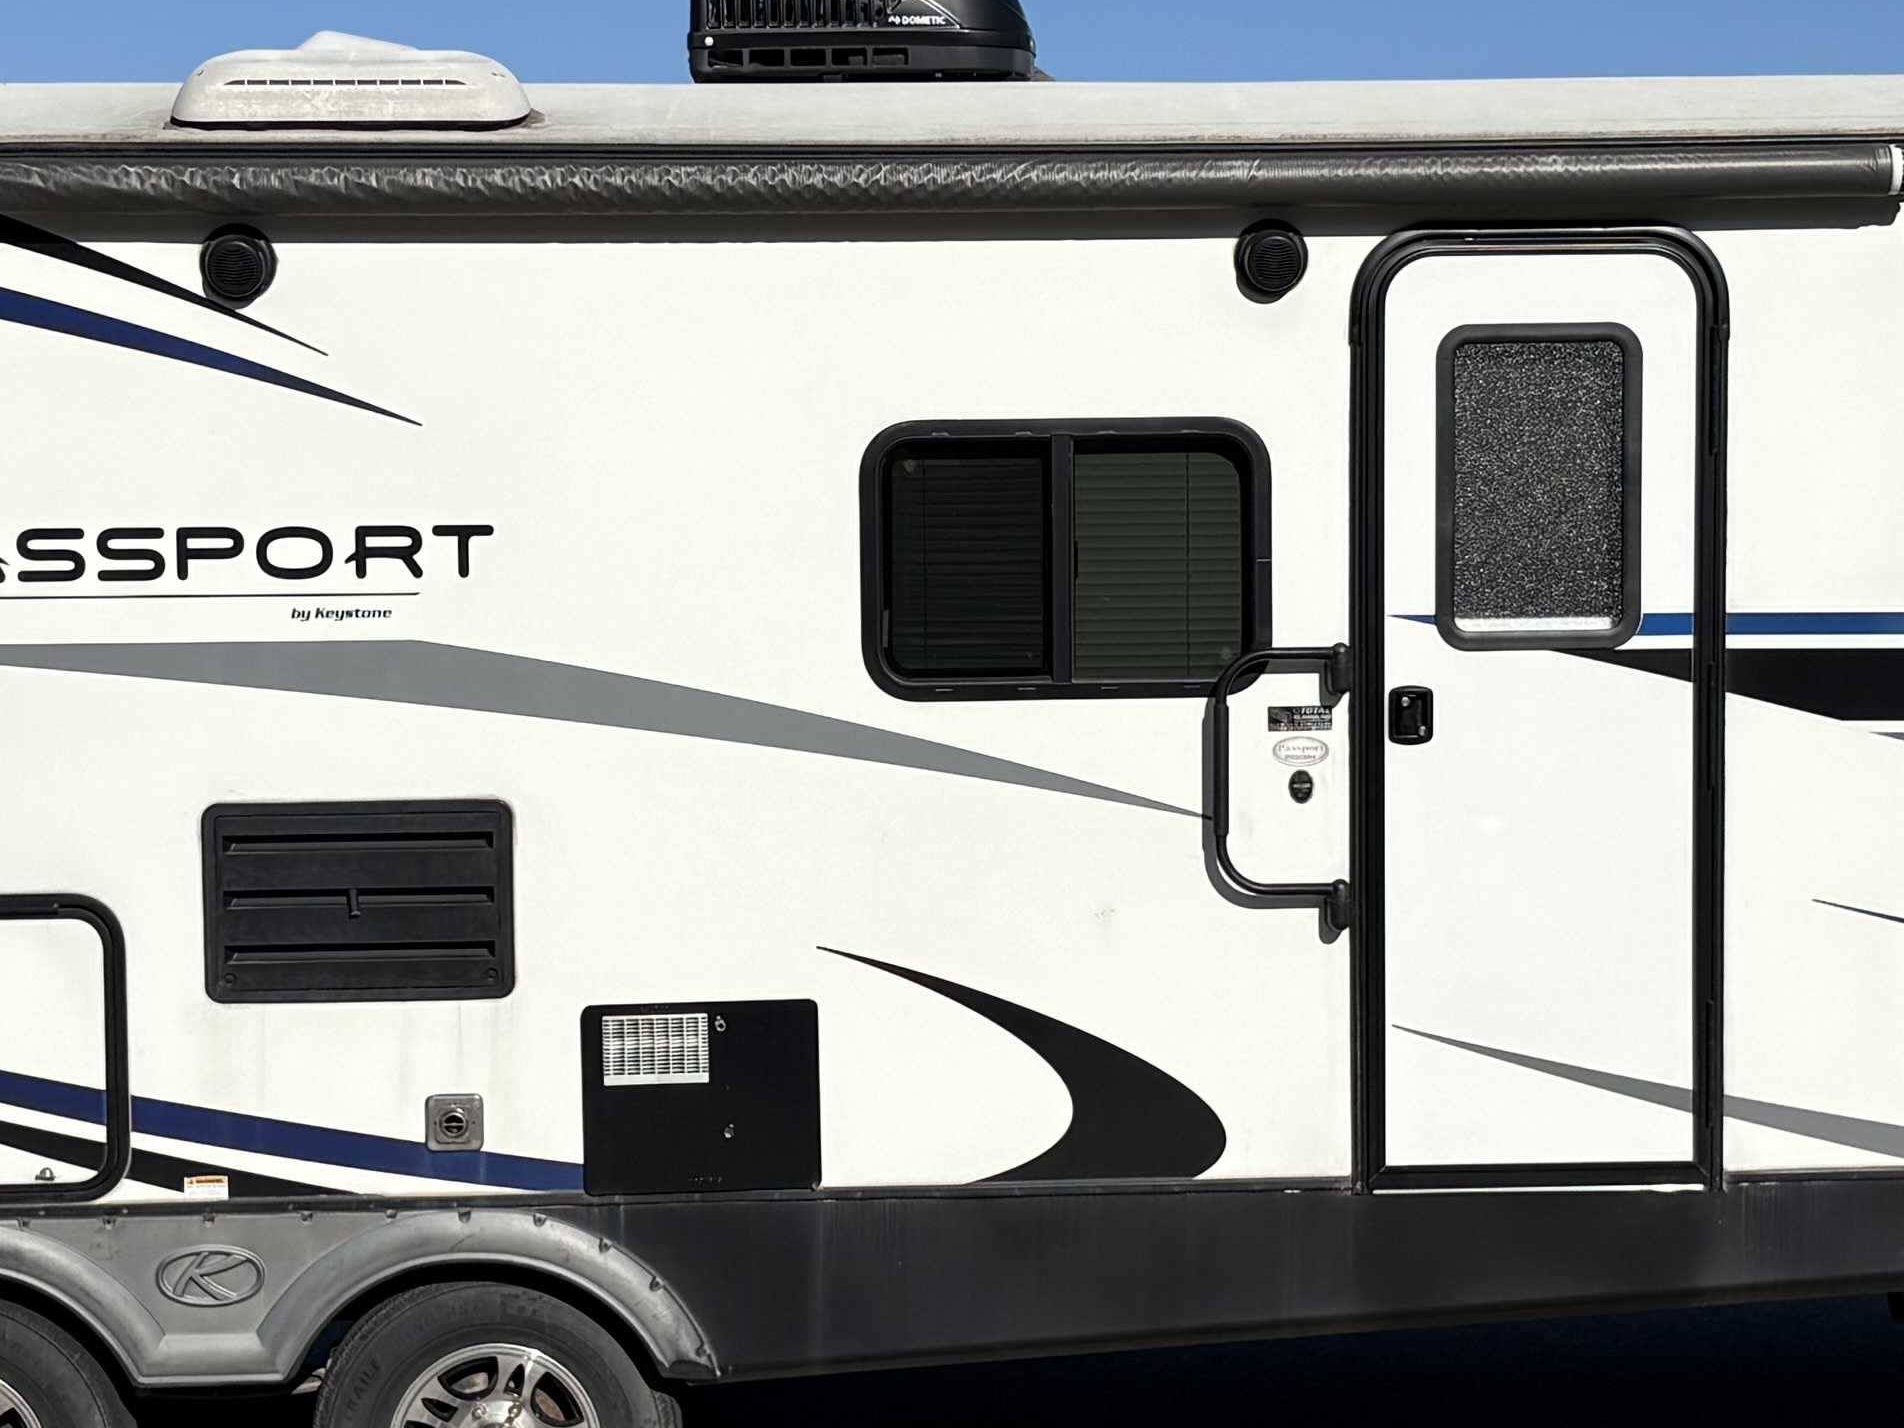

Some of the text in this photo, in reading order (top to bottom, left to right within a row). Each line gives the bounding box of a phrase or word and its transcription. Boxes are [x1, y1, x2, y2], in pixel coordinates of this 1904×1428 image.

[902, 15, 946, 26] DOMETIC
[290, 607, 393, 622] by Keystone
